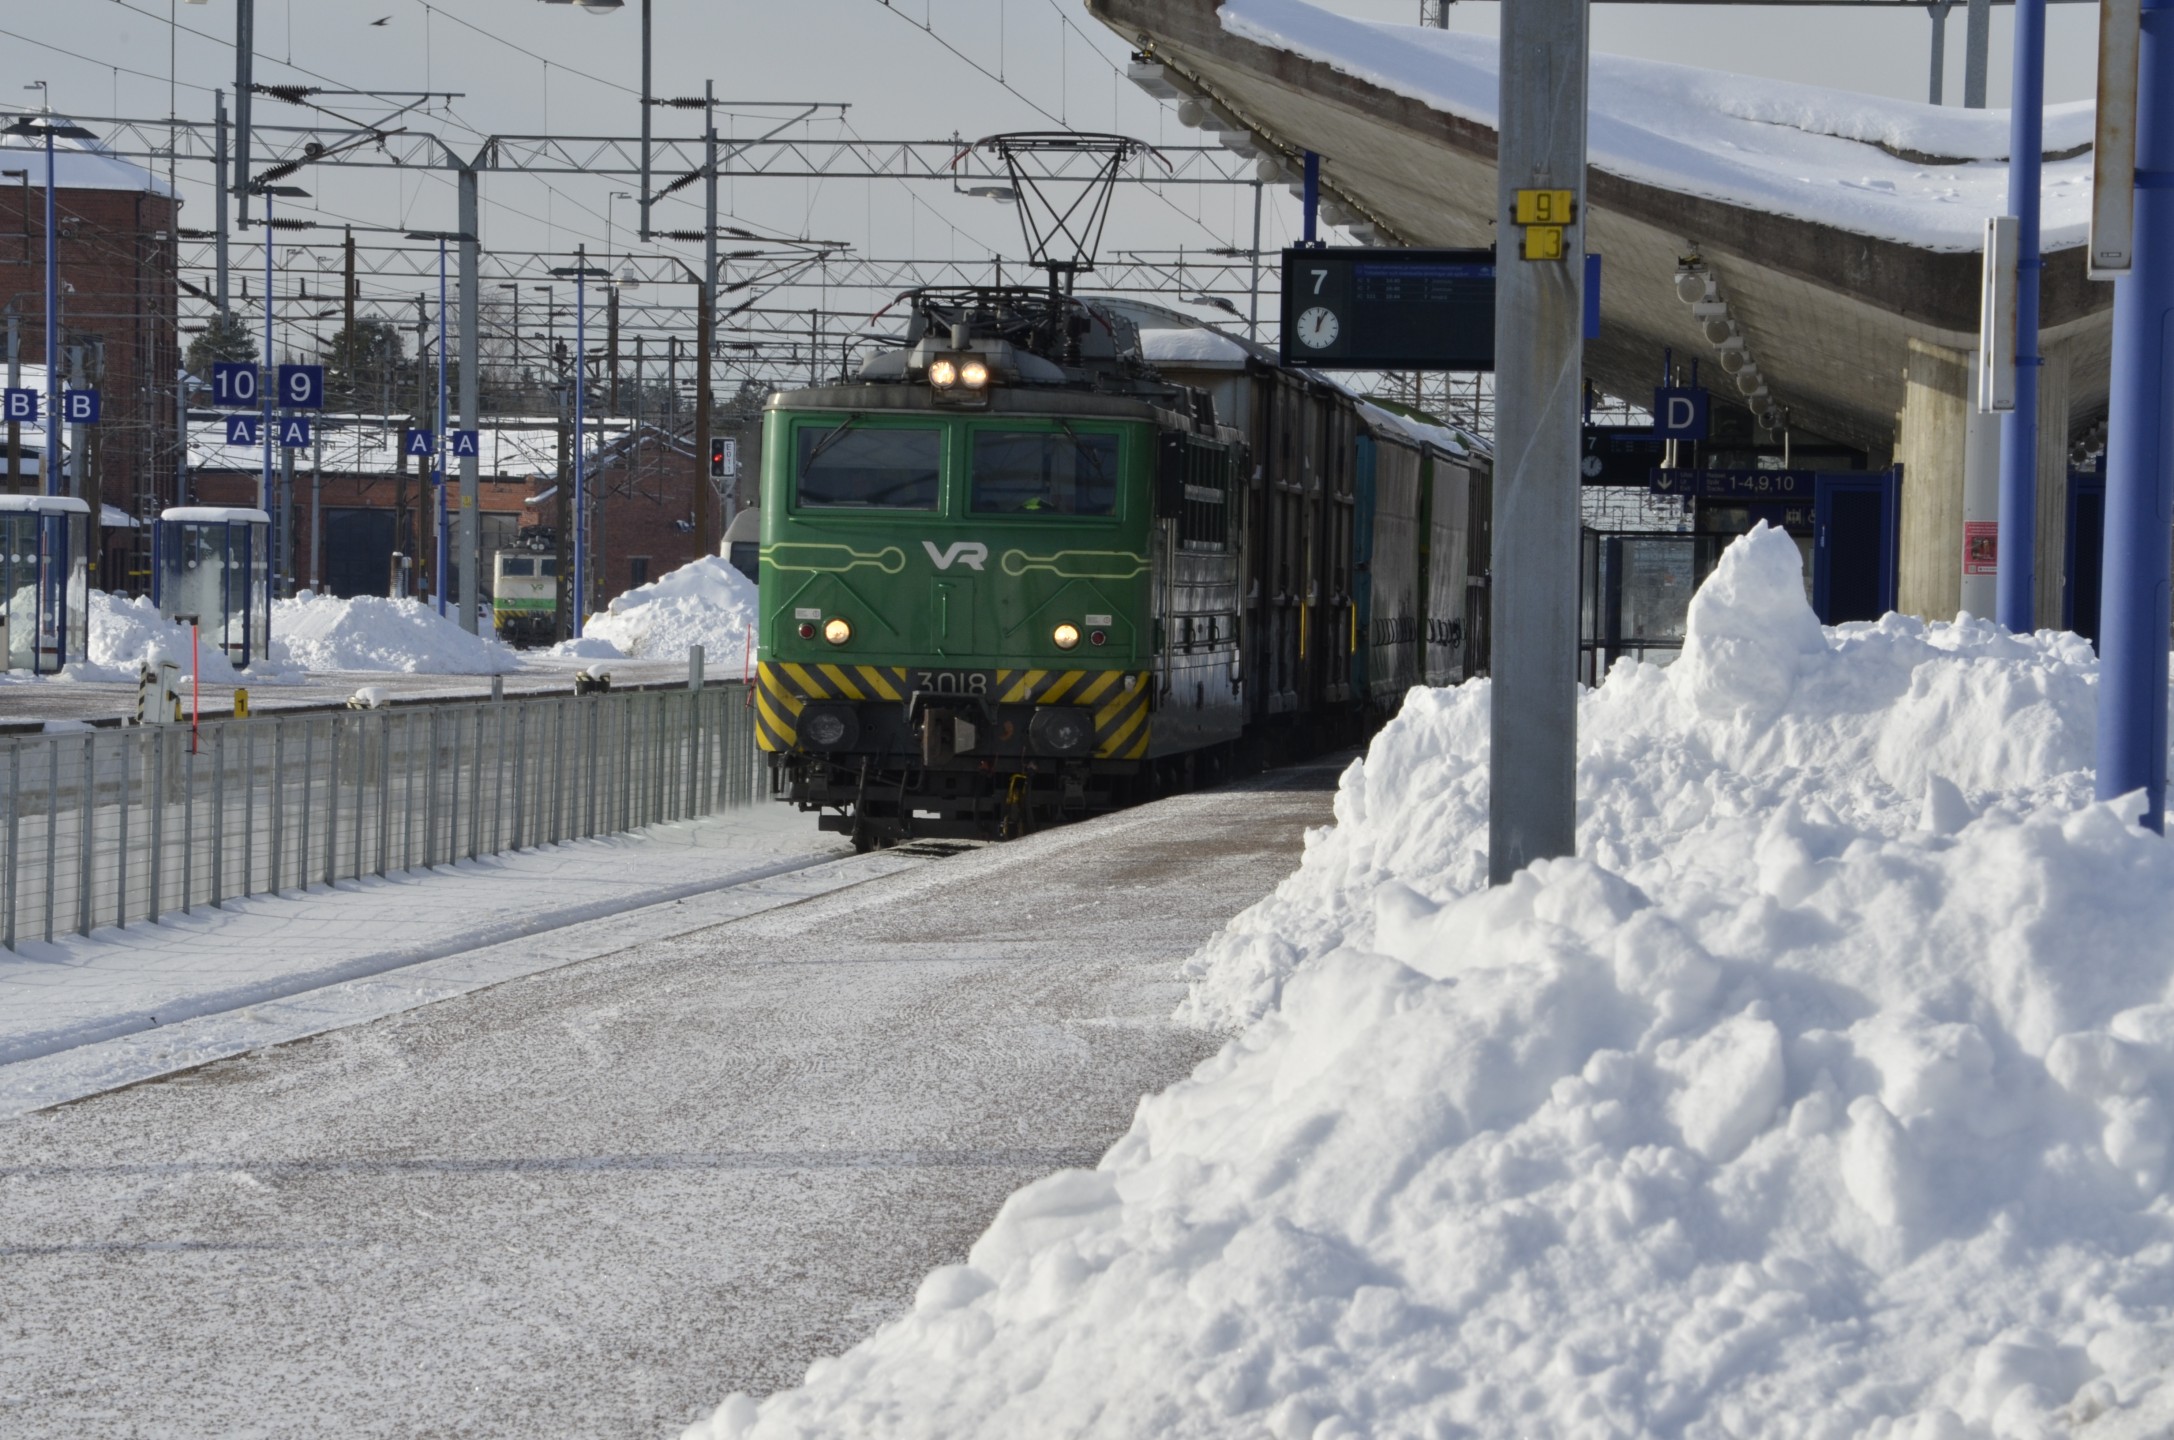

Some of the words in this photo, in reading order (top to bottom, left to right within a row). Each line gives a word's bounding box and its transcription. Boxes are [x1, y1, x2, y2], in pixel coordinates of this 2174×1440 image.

[1537, 193, 1551, 221] 9
[1545, 229, 1560, 257] 3
[1310, 269, 1328, 295] 7
[216, 370, 255, 399] 10
[291, 372, 311, 402] 9
[11, 394, 30, 416] B
[72, 395, 91, 418] B
[1668, 397, 1694, 429] D
[233, 421, 250, 441] A
[285, 422, 303, 443] A
[411, 434, 427, 452] A
[458, 434, 474, 453] A
[1587, 436, 1597, 450] 7
[922, 541, 988, 570] VR
[917, 672, 987, 694] 3018
[237, 698, 245, 713] 1
